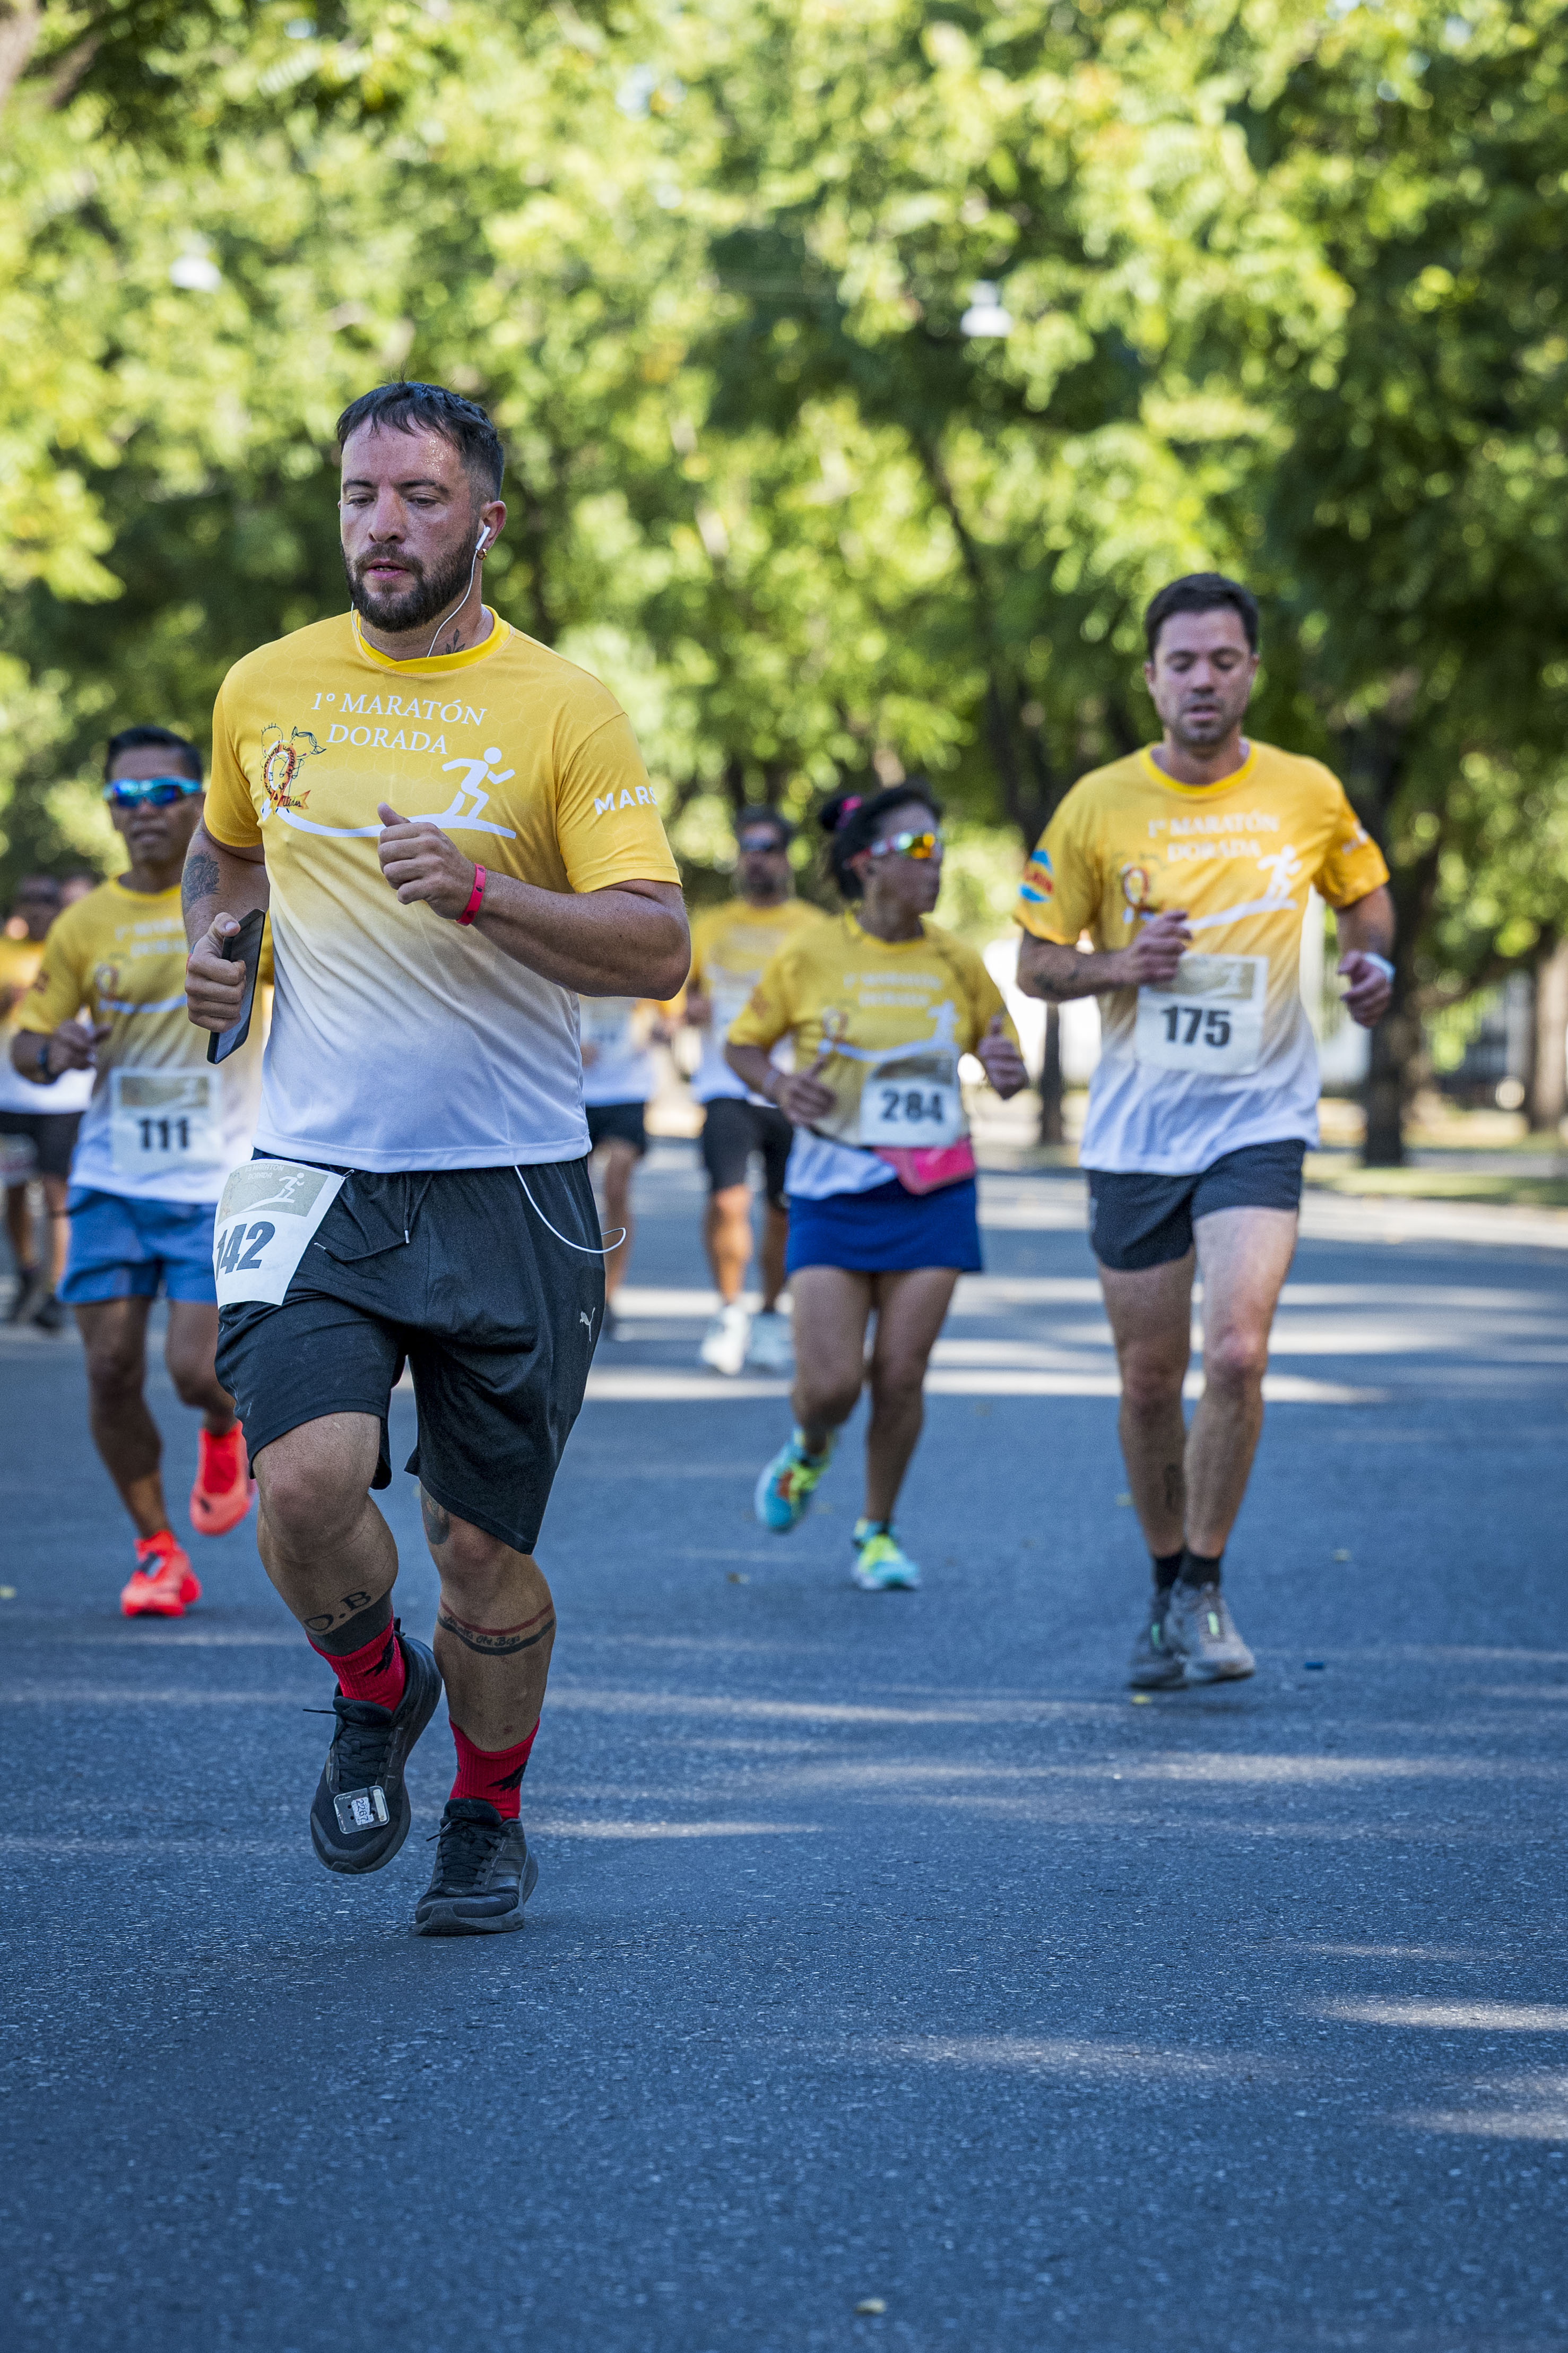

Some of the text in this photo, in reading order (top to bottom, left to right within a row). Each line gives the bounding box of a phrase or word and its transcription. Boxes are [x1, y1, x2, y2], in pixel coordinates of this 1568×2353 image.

[340, 693, 487, 726] MARATÓN
[326, 724, 448, 754] DORADA
[1161, 1006, 1230, 1046] 175
[882, 1089, 943, 1123] 284
[138, 1117, 188, 1151] 111
[356, 1798, 369, 1822] 2267
